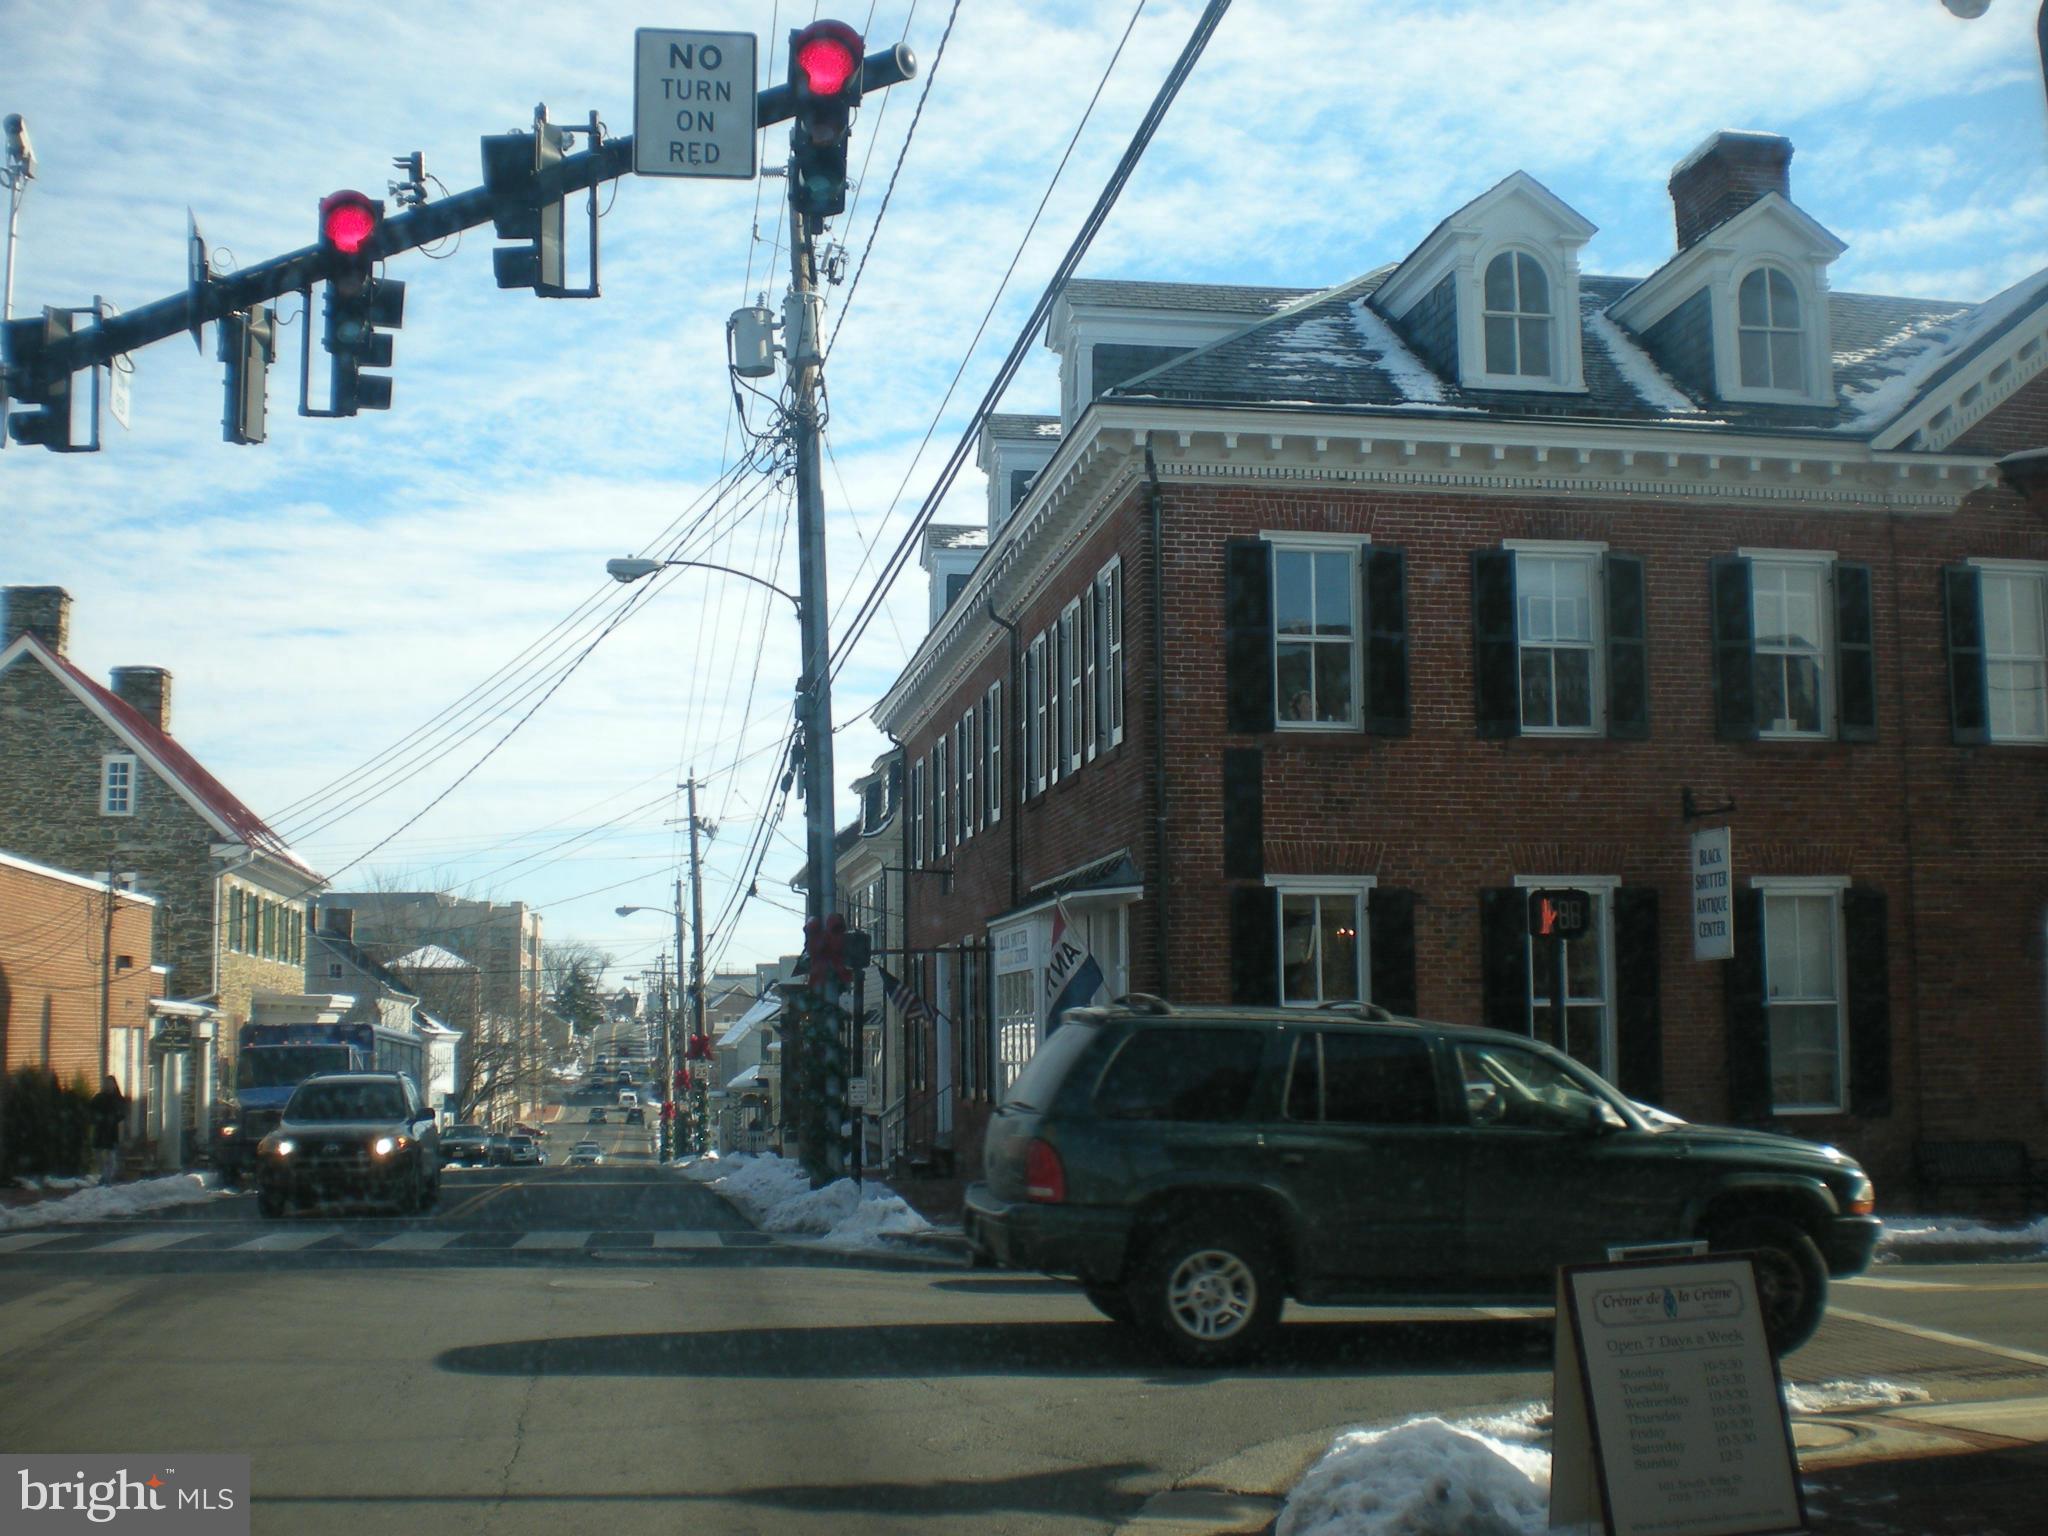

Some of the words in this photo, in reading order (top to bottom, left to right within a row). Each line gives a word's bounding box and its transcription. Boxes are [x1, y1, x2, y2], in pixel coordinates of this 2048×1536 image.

[670, 43, 722, 71] NO
[661, 78, 731, 102] TURN
[676, 110, 715, 133] ON
[669, 141, 720, 165] RED
[1700, 848, 1722, 866] BLACK
[1696, 871, 1726, 890] SHUTTER
[1697, 896, 1727, 914] ANTIQUE
[1699, 920, 1726, 939] CENTER
[1646, 1291, 1661, 1305] de
[1678, 1289, 1689, 1303] la
[1607, 1339, 1643, 1355] Open
[1646, 1336, 1654, 1348] 7
[1659, 1335, 1693, 1351] Days
[1708, 1328, 1744, 1344] Week
[1619, 1366, 1666, 1379] Monday
[1622, 1381, 1670, 1395] Tuesday
[1624, 1395, 1689, 1409] Wednesday
[1626, 1410, 1682, 1425] Thursday
[1629, 1427, 1666, 1441] Friday
[1632, 1441, 1686, 1456] Saturday
[1634, 1456, 1680, 1471] Sunday
